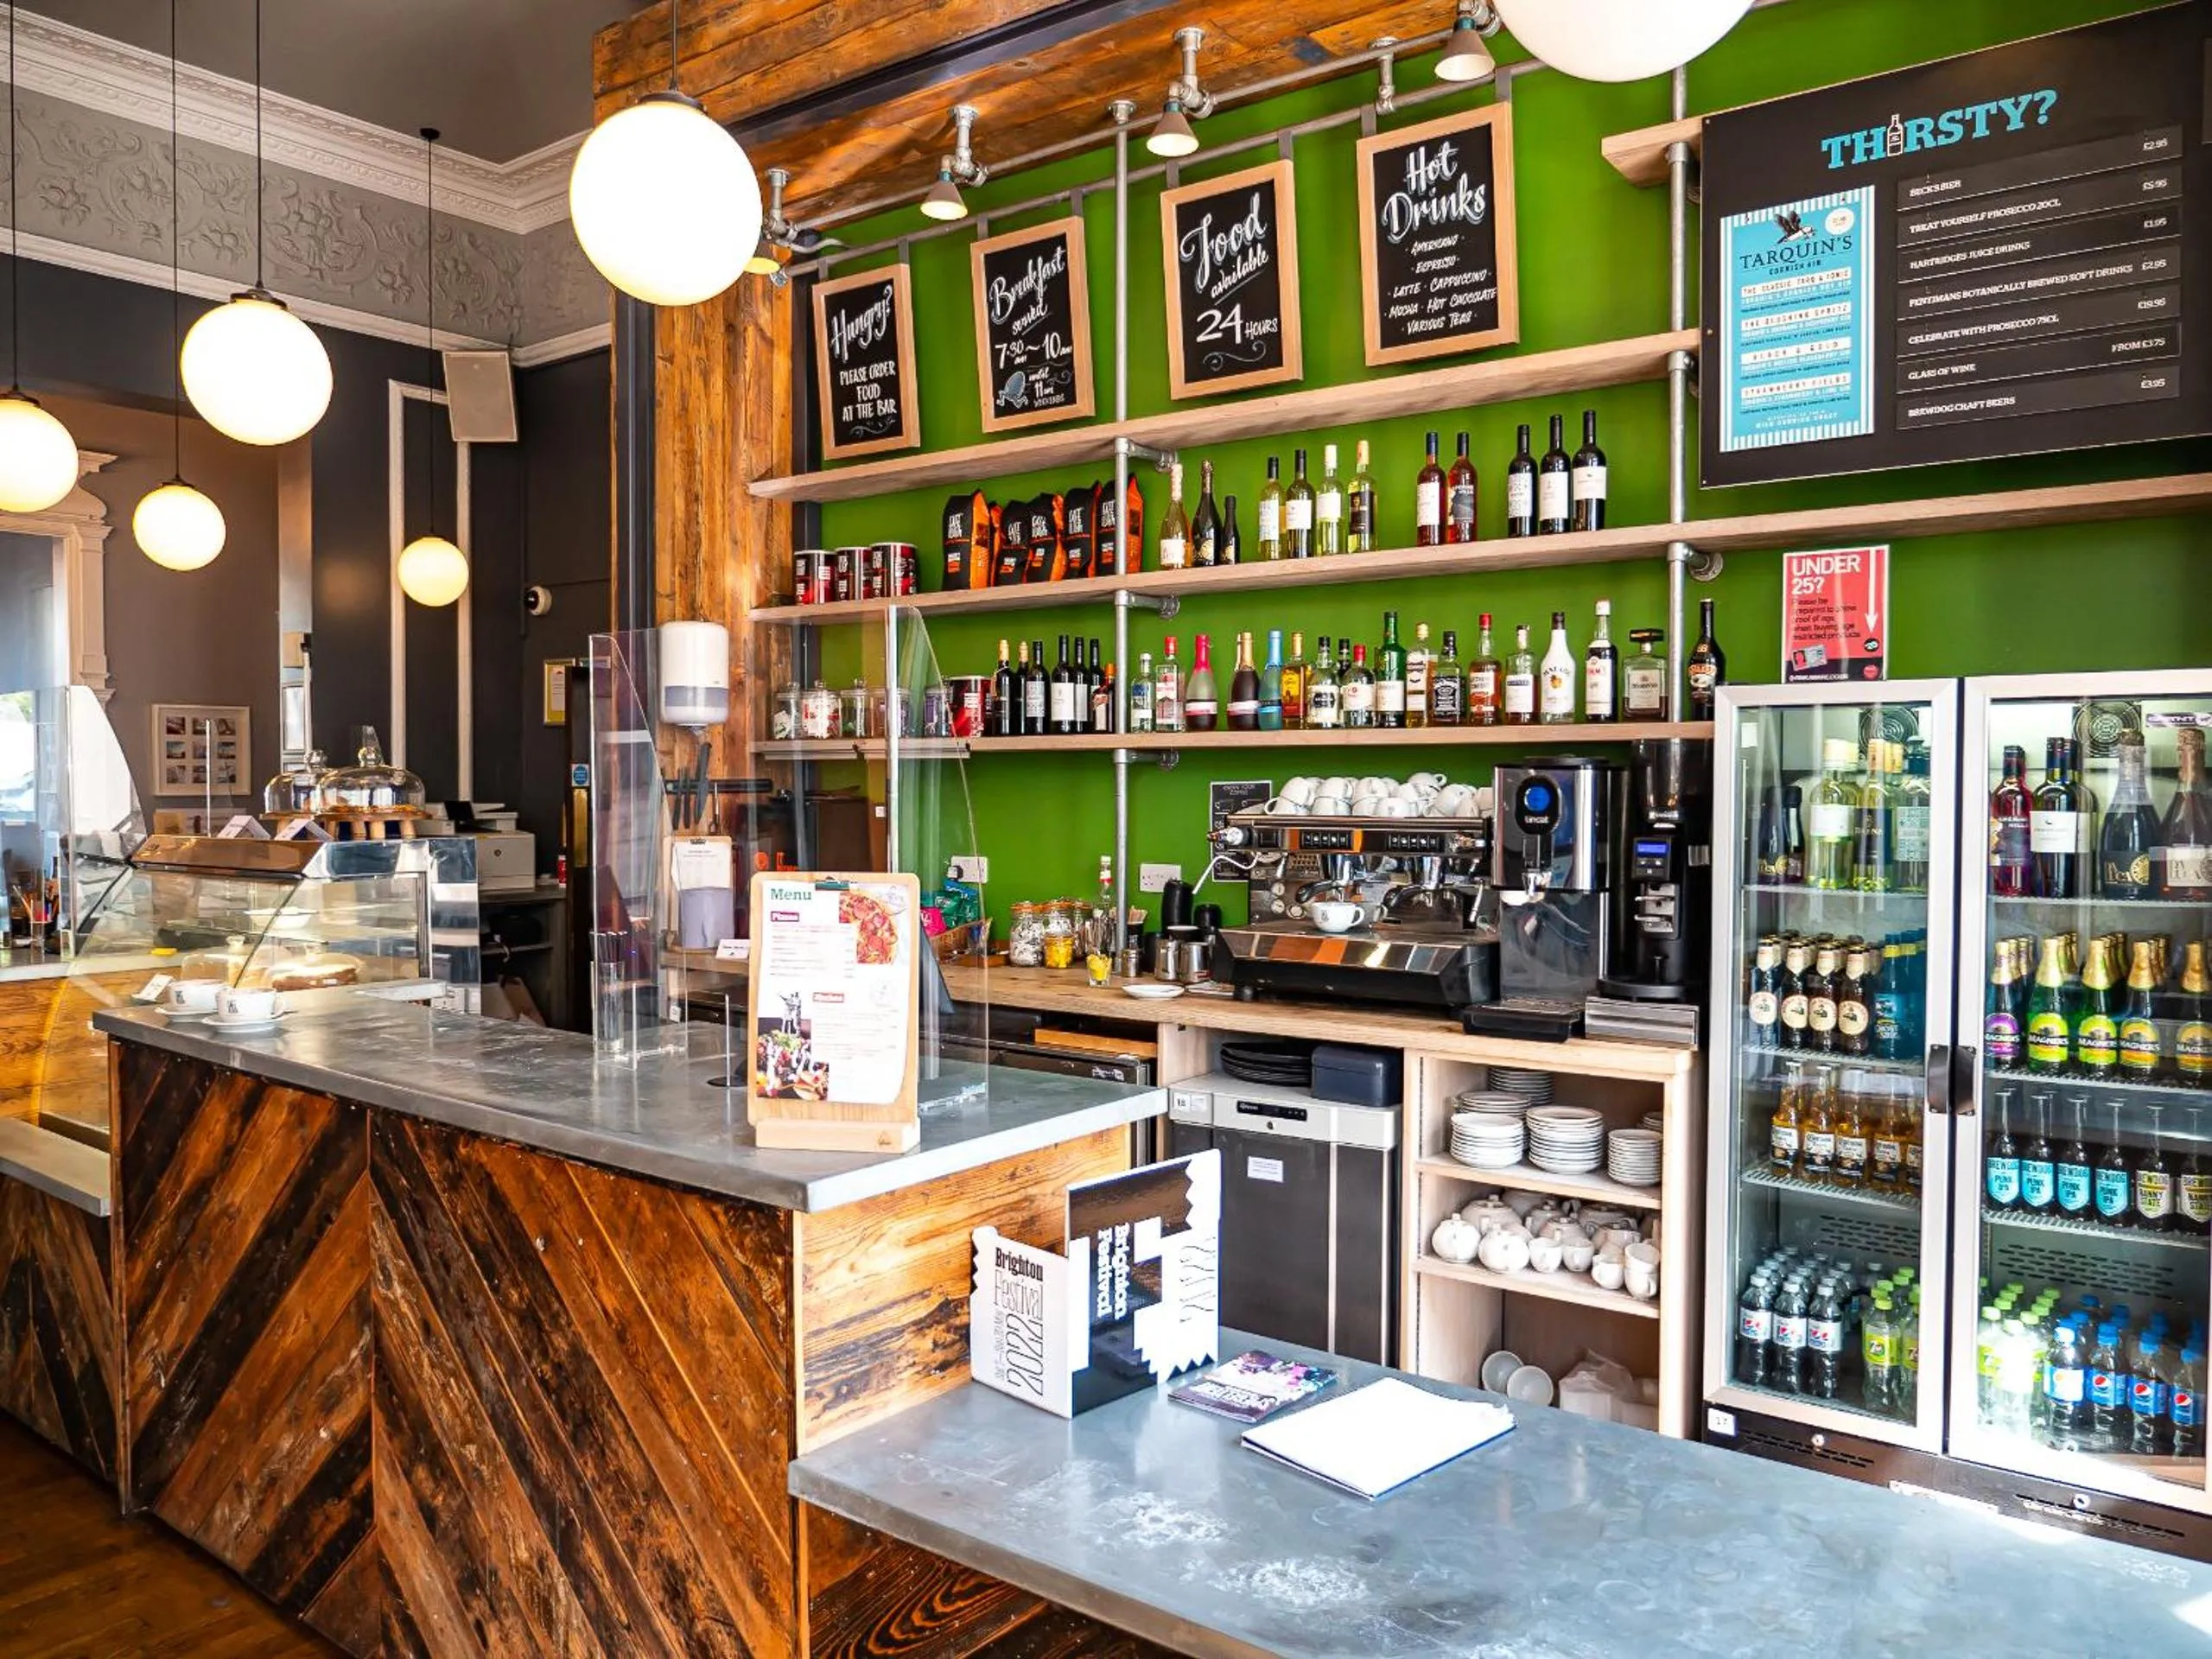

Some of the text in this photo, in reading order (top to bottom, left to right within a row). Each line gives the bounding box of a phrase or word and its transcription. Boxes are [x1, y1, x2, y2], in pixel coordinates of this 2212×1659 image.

[1821, 90, 2057, 168] THIRSTY?
[1406, 141, 1459, 194] Hot
[1941, 180, 1961, 192] BIER
[1382, 173, 1486, 243] Drinks
[1910, 220, 1939, 233] TREAT
[1940, 212, 1987, 228] YOURSELF
[1987, 204, 2036, 219] PROSECCO
[1179, 193, 1268, 293] Food
[1739, 235, 1853, 269] TARQUIN'S
[1969, 246, 1993, 259] JUICE
[1994, 241, 2031, 255] DRINKS
[1211, 243, 1268, 299] available
[1770, 263, 1804, 276] CORNISH
[2142, 259, 2167, 270] £2.95
[989, 245, 1065, 324] Breakfast
[1909, 264, 2133, 308] FENTIMANS BOTANICALLY BREWED SOFT DRINKS
[1012, 299, 1048, 335] served
[1427, 298, 1446, 313] HOT
[830, 284, 893, 362] Hungry?
[1196, 303, 1278, 345] 24 HOURS
[1908, 329, 1961, 345] CELEBRATE
[1961, 325, 1987, 337] WITH
[1987, 317, 2036, 333] PROSECCO
[2112, 340, 2141, 353] FROM
[840, 361, 896, 385] PLEASE ORDER
[1029, 366, 1050, 382] until
[1908, 363, 1977, 380] GLASS OF WINE
[856, 383, 880, 403] FOOD
[1908, 397, 2016, 417] BREWDOG CRAFT BEERS
[842, 398, 897, 422] AT THE BAR
[1792, 555, 1860, 575] UNDER
[1792, 576, 1825, 594] 25?
[771, 888, 812, 900] Menu
[995, 1247, 1043, 1282] Brighton
[995, 1269, 1043, 1320] Festival
[1005, 1313, 1044, 1396] 2022
